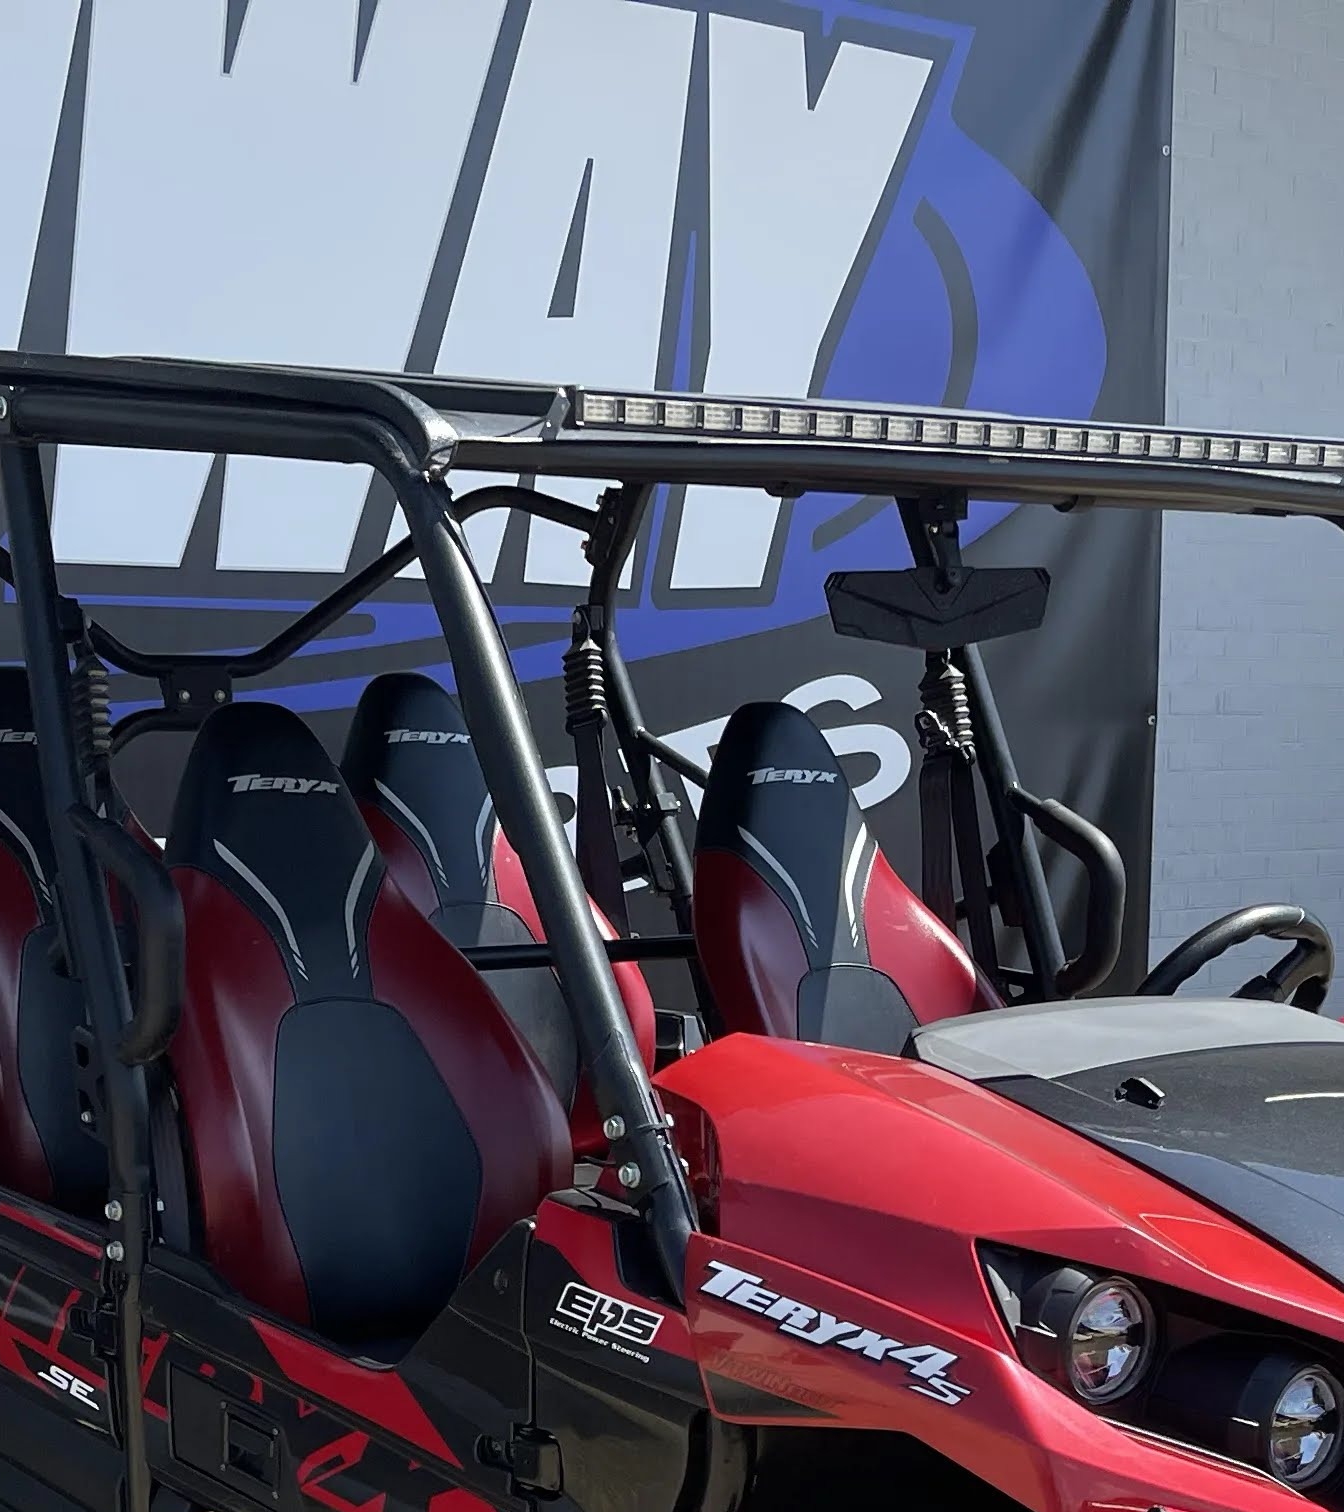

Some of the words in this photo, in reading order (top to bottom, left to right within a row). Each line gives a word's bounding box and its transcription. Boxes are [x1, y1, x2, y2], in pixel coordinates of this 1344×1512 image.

[227, 773, 340, 794] TERYX
[746, 766, 838, 785] TERYX
[556, 1281, 665, 1345] EPS
[549, 1317, 579, 1335] Electric
[581, 1331, 609, 1347] Power
[611, 1342, 650, 1364] Steering
[37, 1364, 100, 1411] SE
